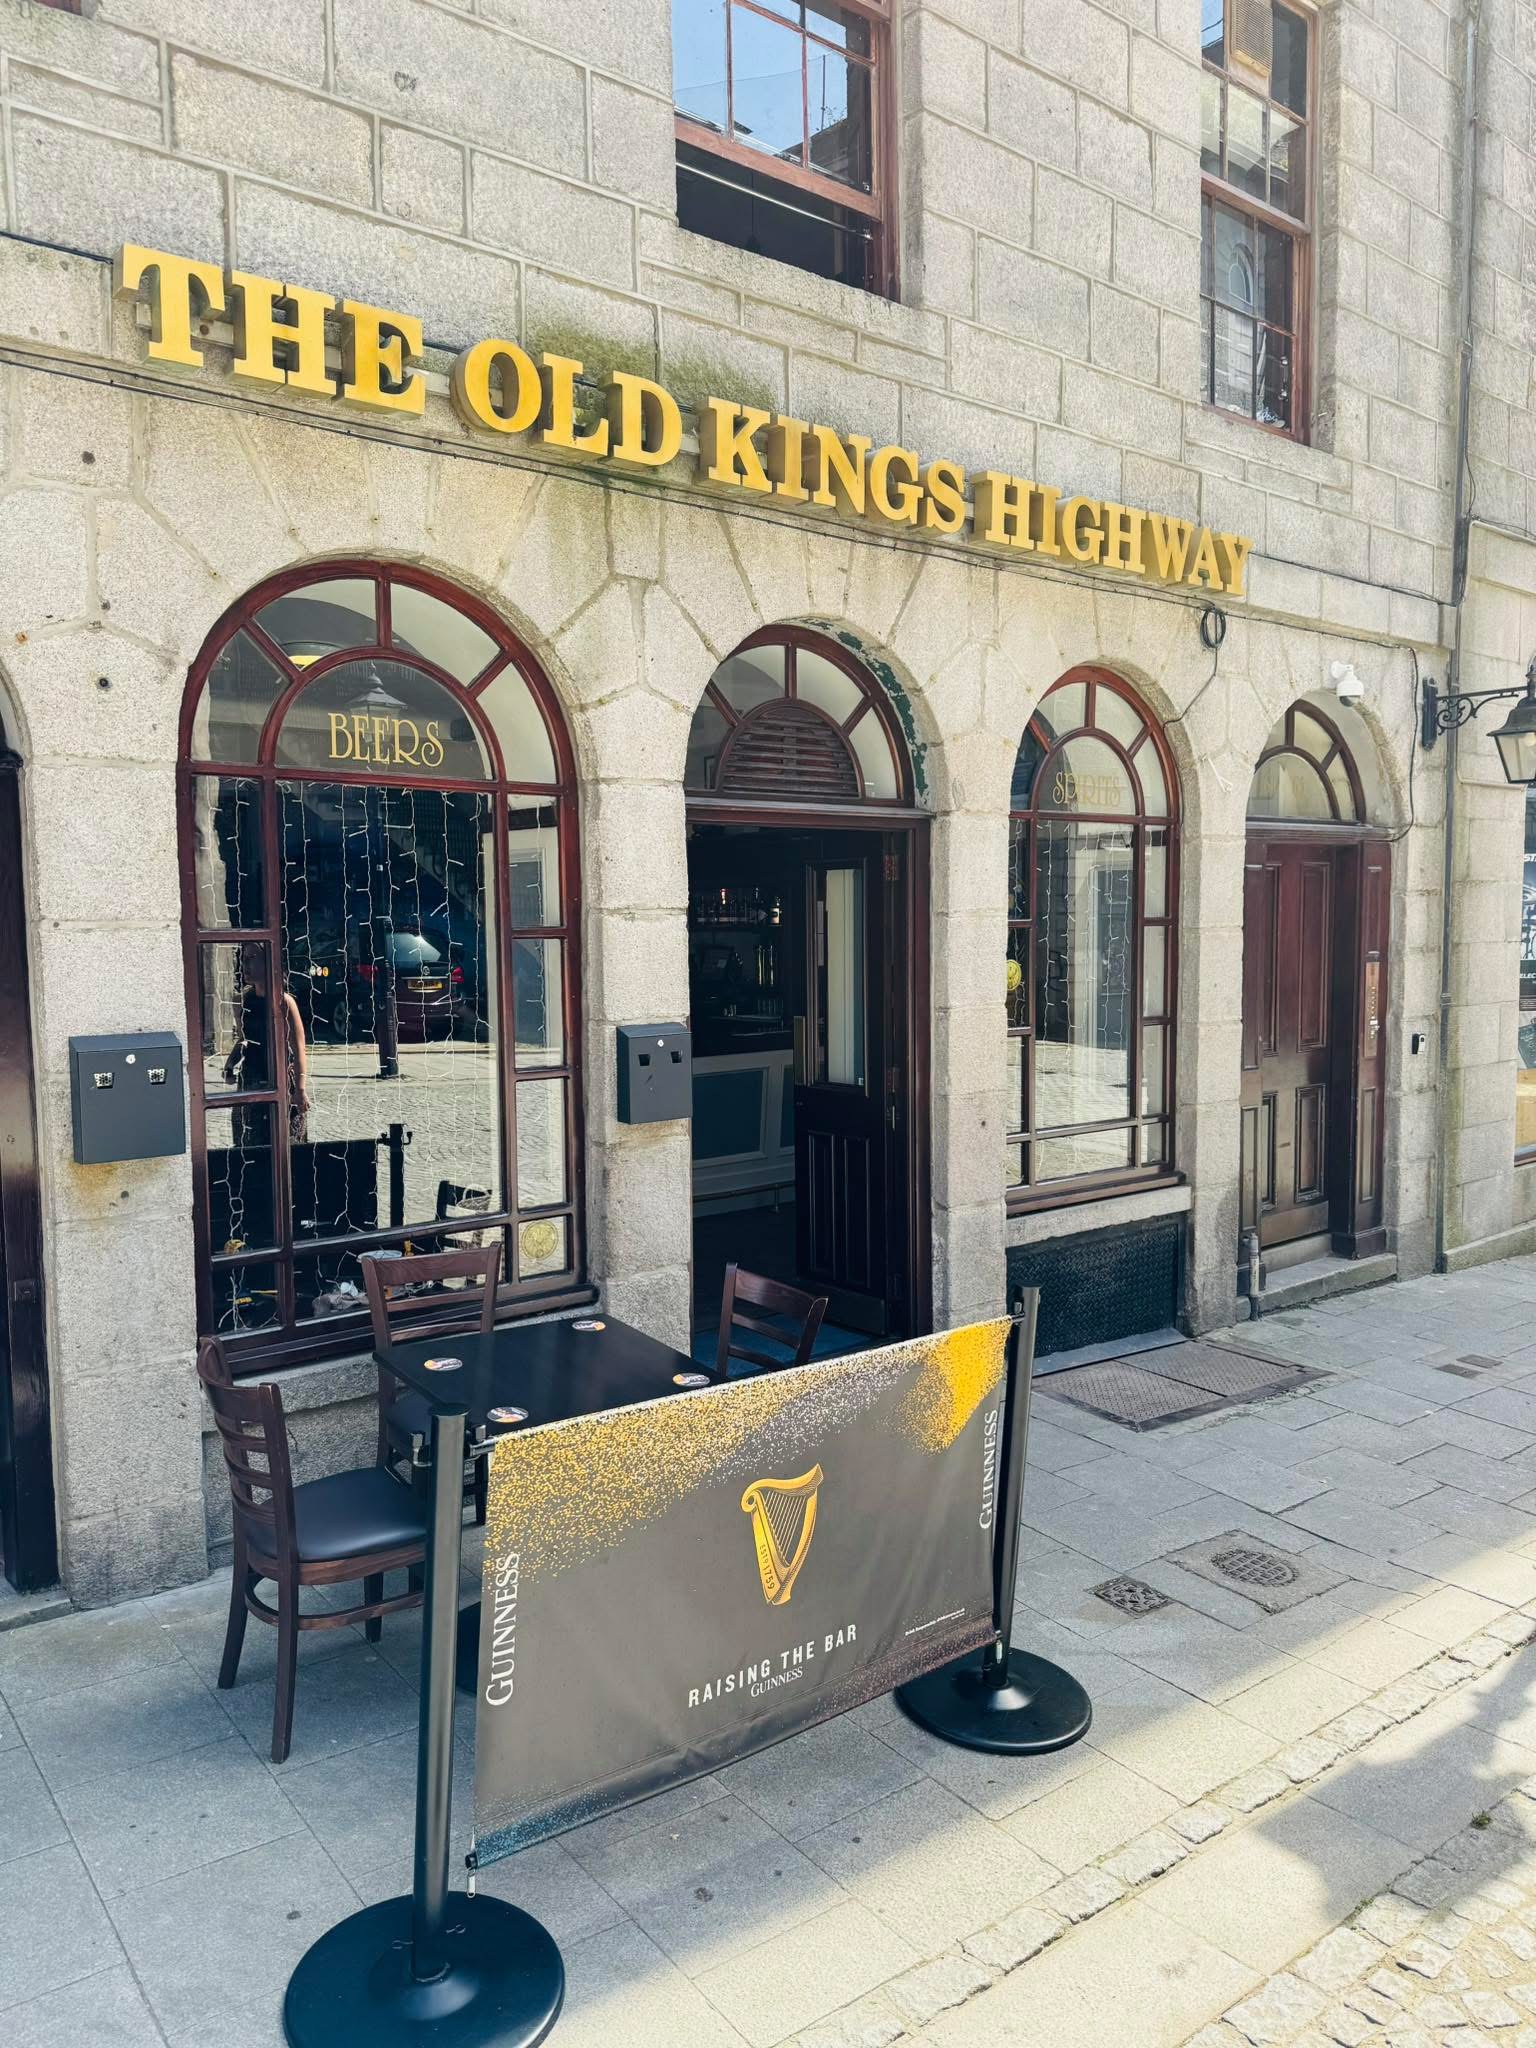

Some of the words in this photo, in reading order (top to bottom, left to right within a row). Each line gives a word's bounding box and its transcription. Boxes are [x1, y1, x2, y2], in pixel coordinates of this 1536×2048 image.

[117, 244, 425, 415] THE
[455, 338, 683, 466] OLD
[706, 396, 966, 535] KINGS
[978, 470, 1253, 597] HIGHWAY
[327, 712, 445, 767] BEERS
[1052, 771, 1121, 806] SPIRITS
[979, 1409, 998, 1529] GUINNESS
[763, 1565, 775, 1590] 1759
[485, 1552, 520, 1706] GUINNESS
[688, 1659, 771, 1707] RAISING
[780, 1640, 815, 1669] THE
[824, 1624, 857, 1653] BAR
[750, 1666, 803, 1697] GUINNESS
